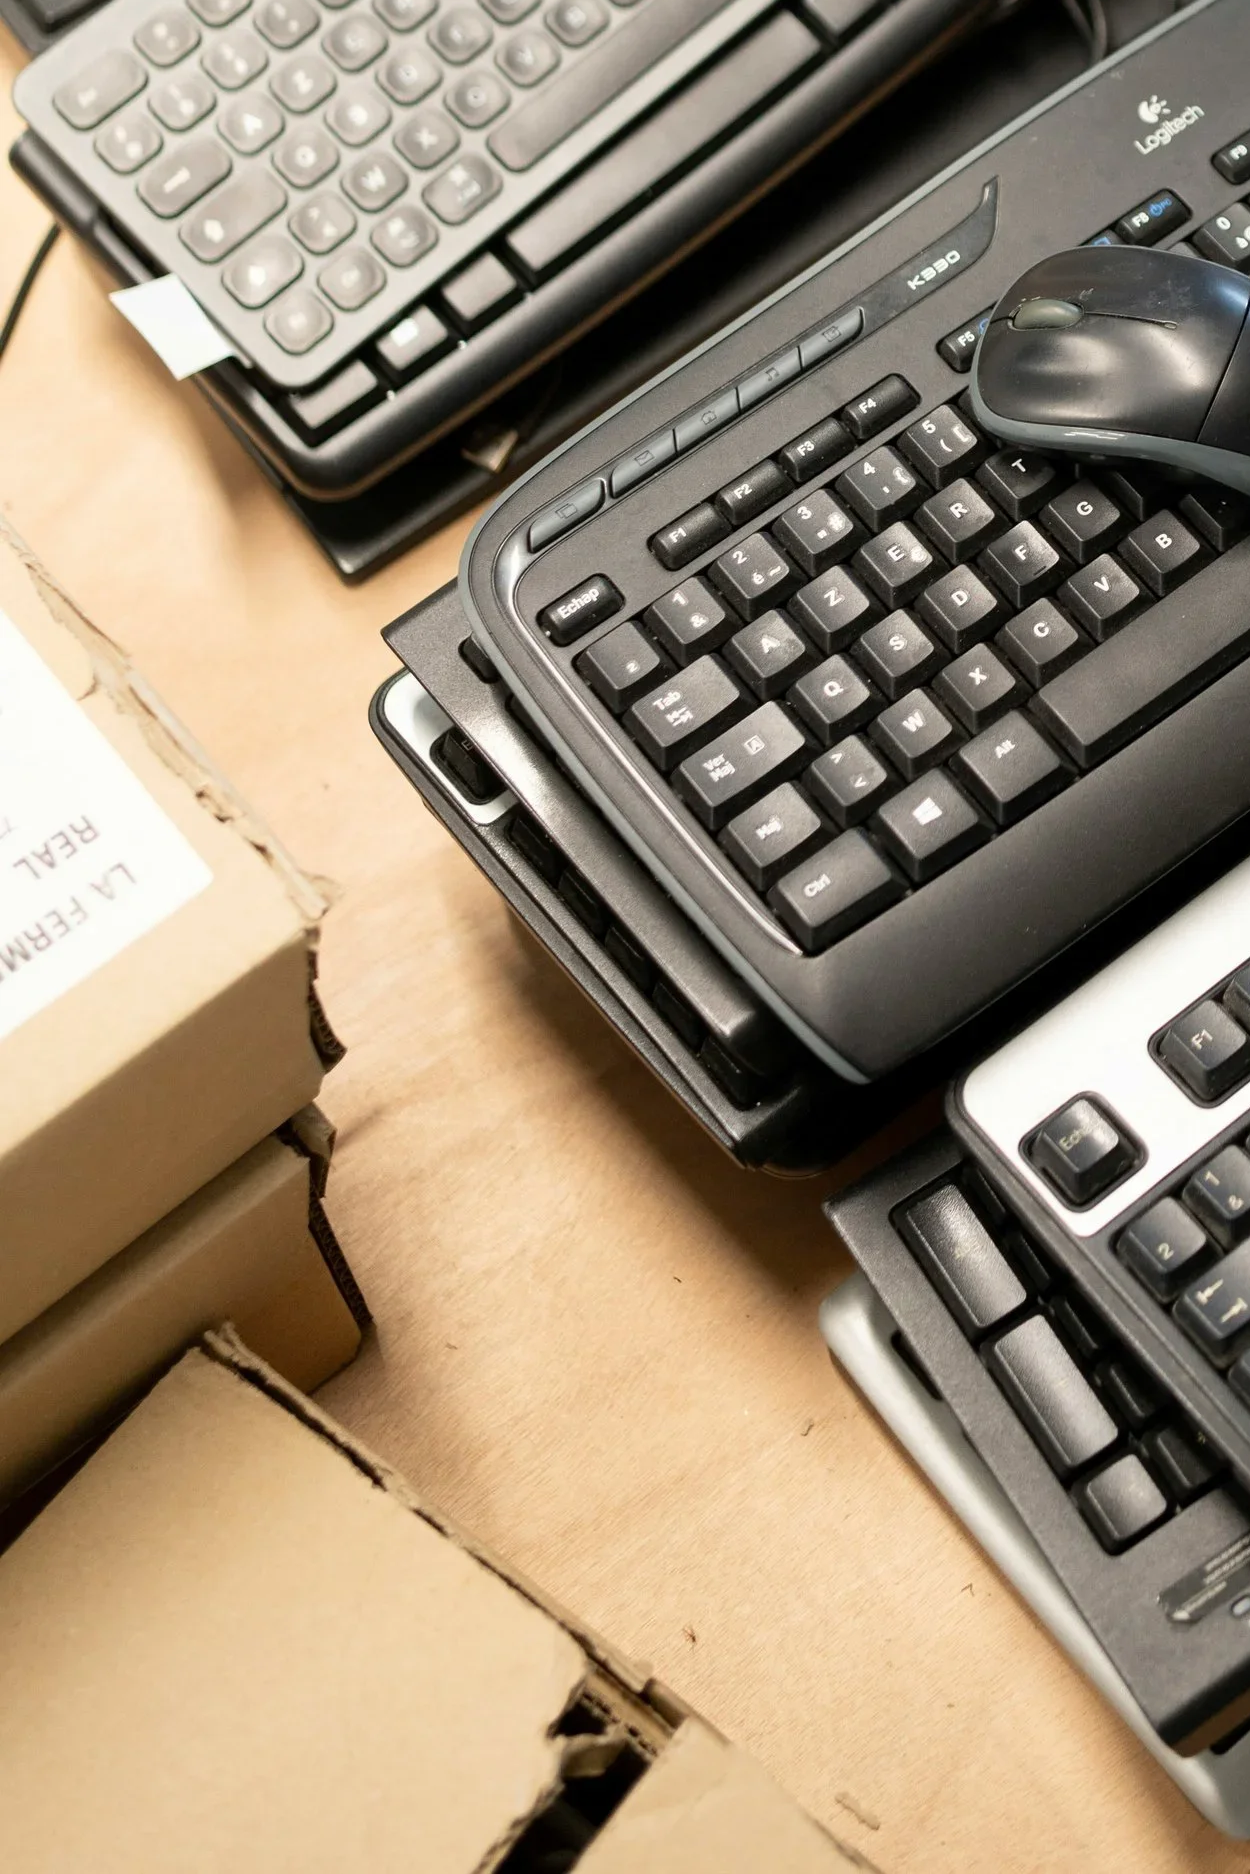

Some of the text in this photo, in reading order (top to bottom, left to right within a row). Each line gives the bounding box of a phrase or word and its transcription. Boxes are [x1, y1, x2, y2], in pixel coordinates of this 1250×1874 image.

[1135, 106, 1204, 154] Logitech
[1230, 145, 1247, 159] F9
[1132, 212, 1149, 227] F8
[907, 251, 960, 290] K330
[958, 331, 975, 346] F5
[859, 396, 876, 414] F4
[922, 420, 936, 433] 5
[798, 440, 814, 457] F3
[864, 462, 875, 475] 4
[1011, 459, 1026, 474] T
[734, 484, 752, 500] F2
[797, 506, 812, 519] 3
[950, 502, 968, 520] R
[1077, 502, 1093, 515] G
[669, 527, 687, 544] F1
[1157, 533, 1172, 550] B
[732, 550, 747, 564] 2
[887, 546, 904, 562] E
[1015, 545, 1029, 560] F
[1094, 576, 1109, 591] V
[557, 588, 600, 620] Echap
[673, 592, 687, 605] 1
[824, 588, 844, 606] Z
[951, 590, 968, 606] D
[1034, 622, 1049, 637] C
[760, 635, 780, 654] A
[889, 636, 904, 652] S
[969, 668, 987, 685] X
[824, 681, 844, 697] Q
[653, 691, 681, 710] Tab
[902, 711, 923, 732] W
[995, 740, 1015, 758] Alt
[13, 815, 100, 879] REAL
[804, 874, 830, 896] Ctrl
[0, 861, 137, 984] LA FERM
[1192, 1030, 1212, 1049] F1
[1204, 1172, 1220, 1186] 1
